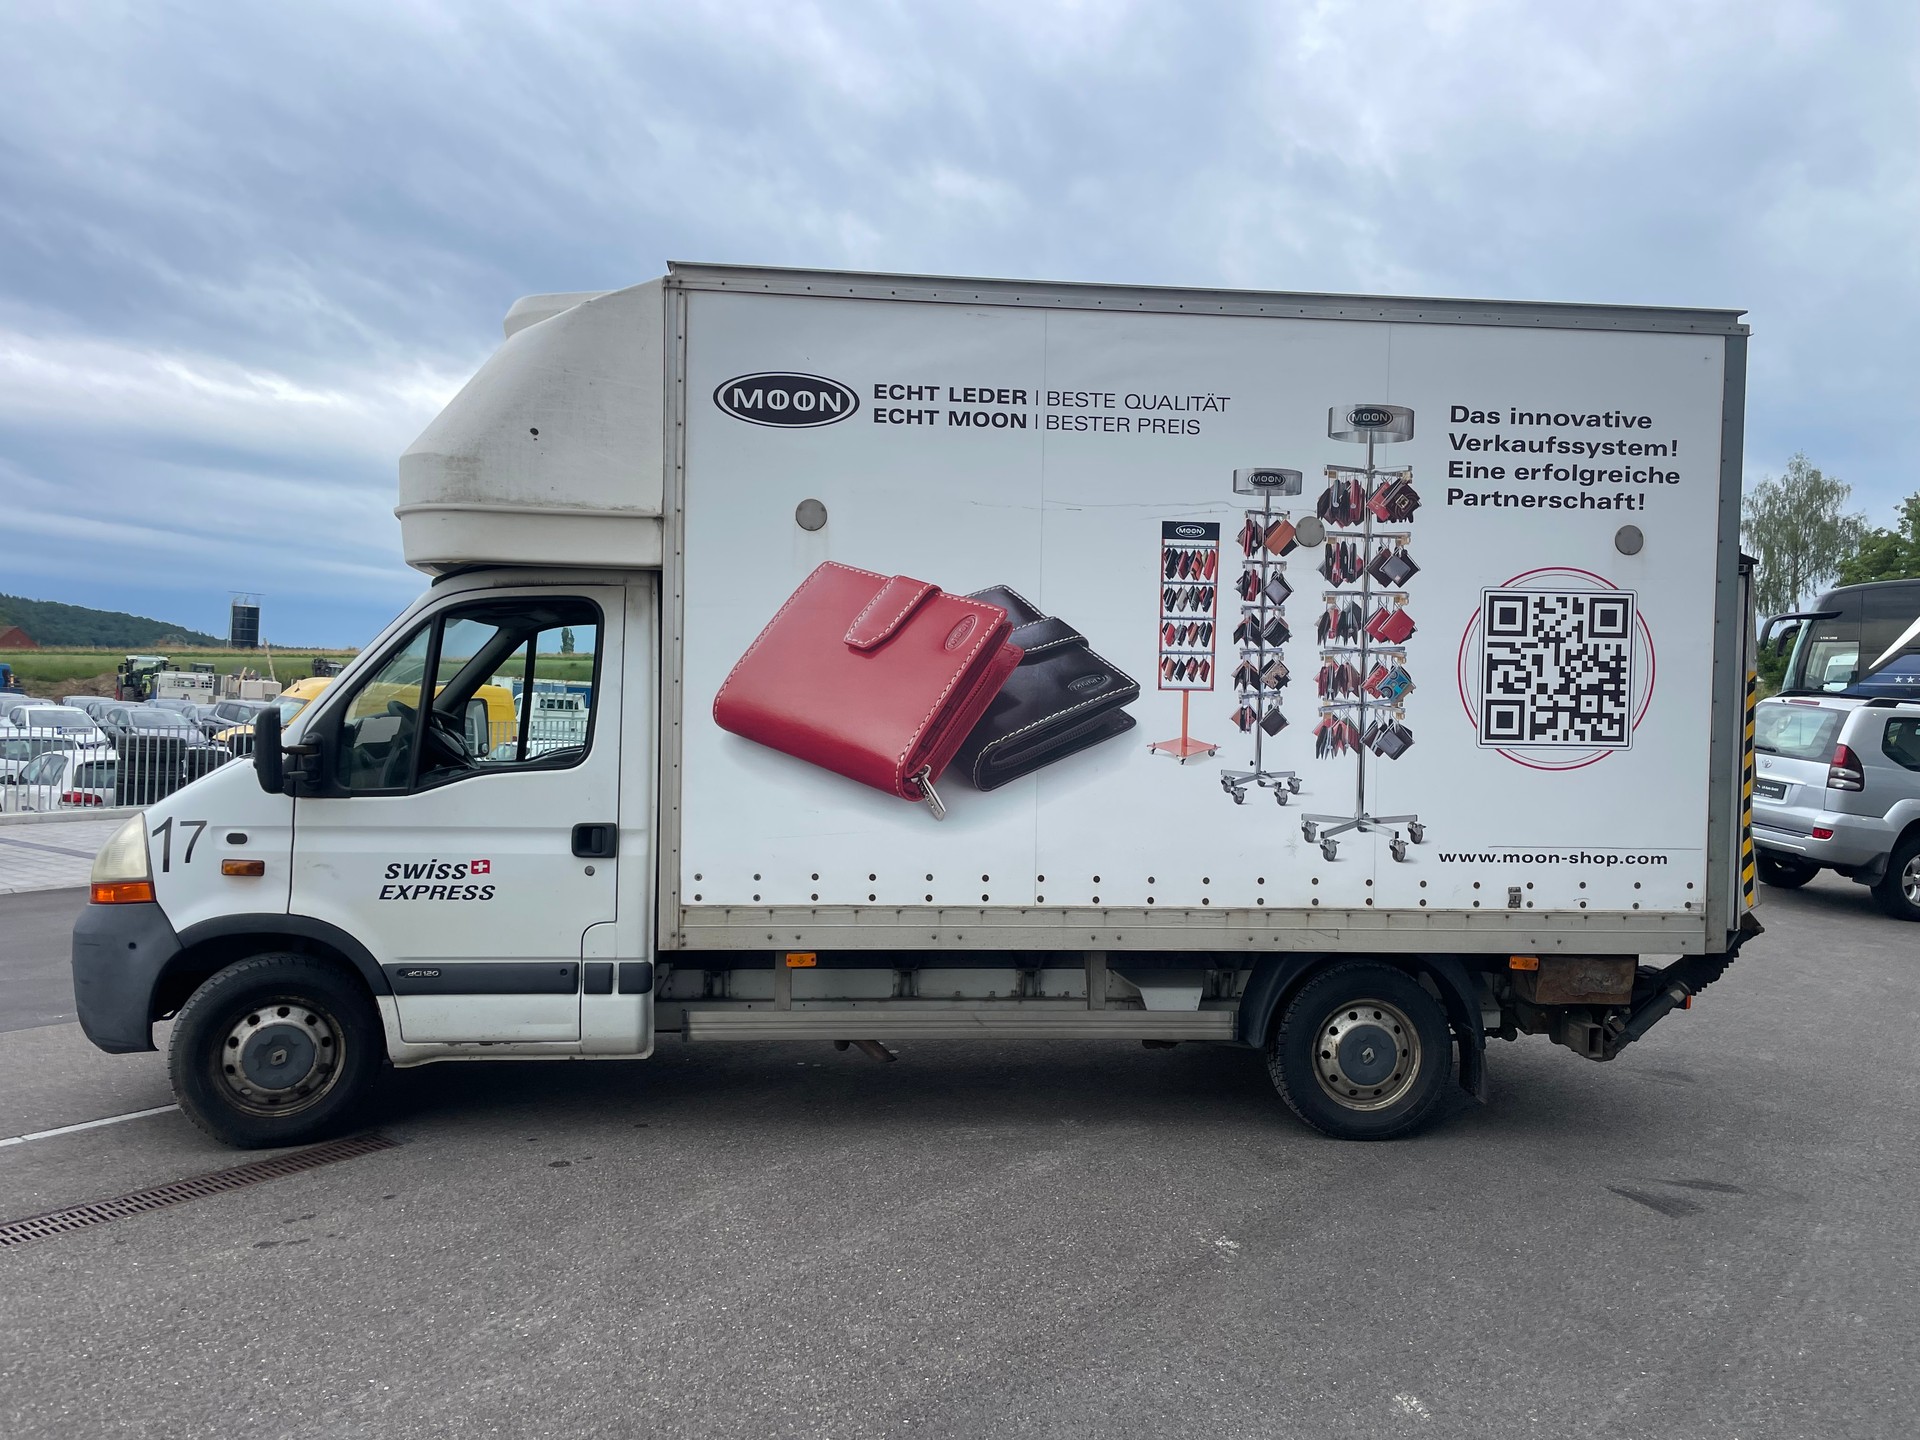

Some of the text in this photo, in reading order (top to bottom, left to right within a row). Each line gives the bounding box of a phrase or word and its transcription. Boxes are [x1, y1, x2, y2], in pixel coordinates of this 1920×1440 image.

[732, 387, 842, 413] MOON
[873, 383, 1231, 412] ECHT LEDER BESTE QUALITÄT
[873, 407, 1201, 436] ECHT MOON BESTER PREIS
[1351, 412, 1389, 422] MOON
[1450, 404, 1653, 429] Das innovative
[1448, 432, 1679, 459] Verkaufssystem!
[1252, 475, 1283, 483] MOON
[1447, 460, 1681, 487] Eine erfolgreiche
[1447, 487, 1645, 511] Partnerschaft!
[152, 816, 208, 873] 17
[1438, 851, 1669, 868] www.moon-shop.com
[378, 884, 496, 901] EXPRESS
